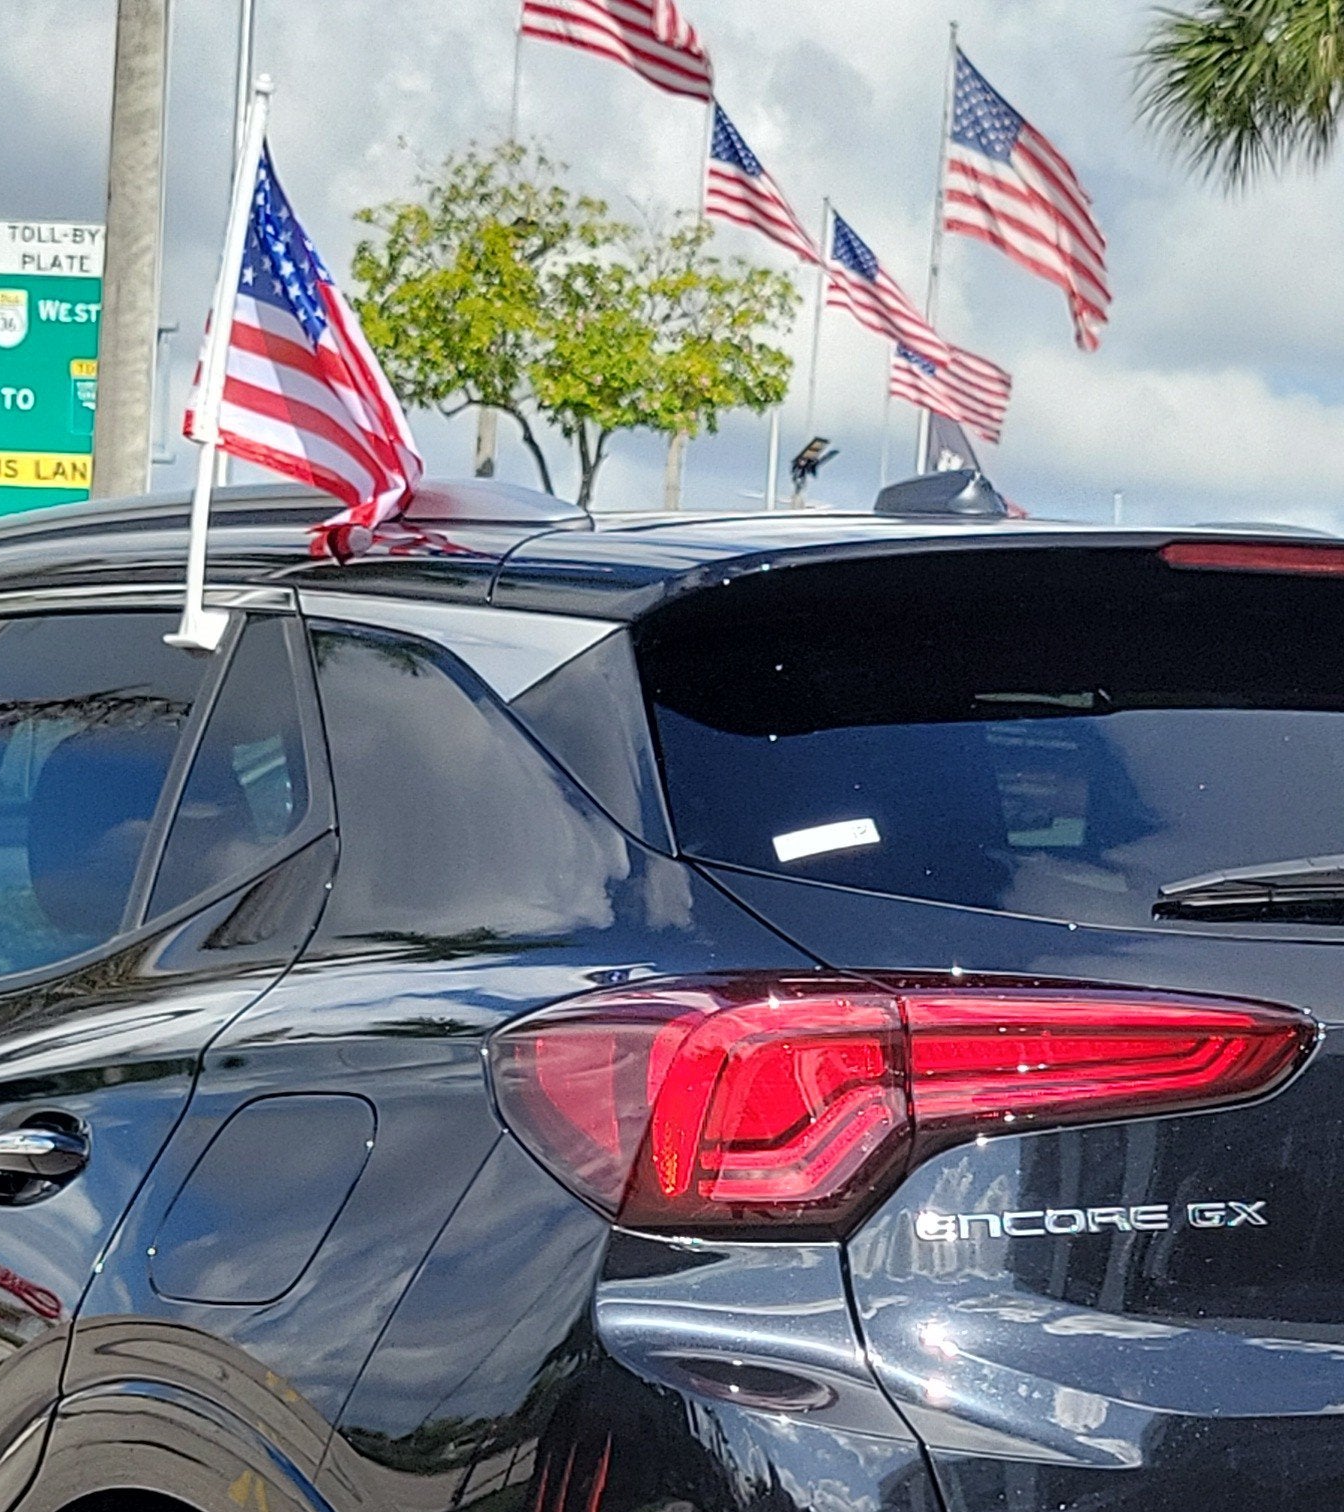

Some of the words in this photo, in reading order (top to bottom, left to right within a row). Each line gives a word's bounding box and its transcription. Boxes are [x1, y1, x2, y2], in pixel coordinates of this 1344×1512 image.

[21, 253, 91, 273] PLATE
[38, 299, 102, 323] WEST
[1, 387, 35, 410] TO
[915, 1204, 1170, 1243] ENCORE
[1187, 1201, 1269, 1229] GX
